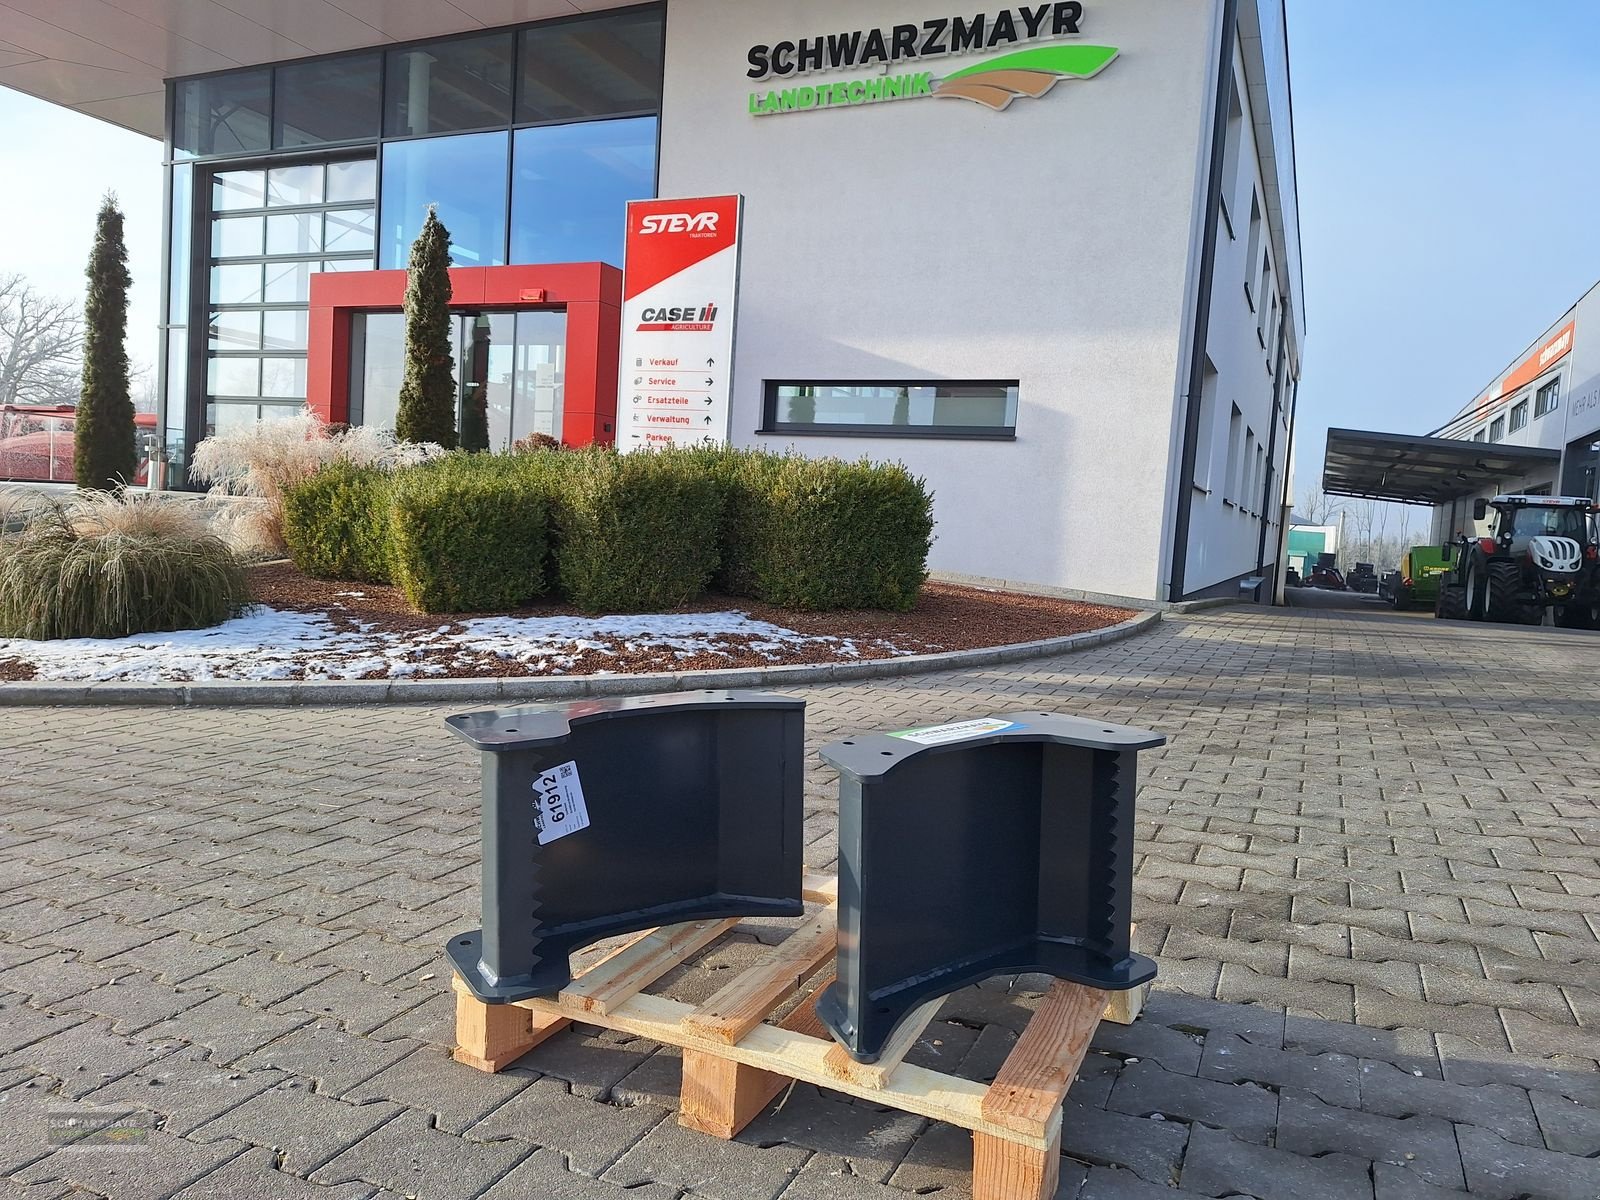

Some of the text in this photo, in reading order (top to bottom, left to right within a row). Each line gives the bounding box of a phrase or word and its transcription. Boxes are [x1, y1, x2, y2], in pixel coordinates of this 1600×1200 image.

[746, 1, 1082, 78] SCHWARZMAYR
[748, 71, 932, 115] LANDTECHNIK
[639, 211, 719, 234] STEYR
[641, 307, 697, 322] CASE
[671, 323, 711, 331] AGRICULTURE
[649, 358, 678, 366] Verkauf
[648, 377, 676, 386] Service
[647, 396, 689, 405] Ersatzteile
[647, 415, 690, 425] Verwaltung
[646, 433, 672, 442] Parken
[542, 774, 565, 823] 61912
